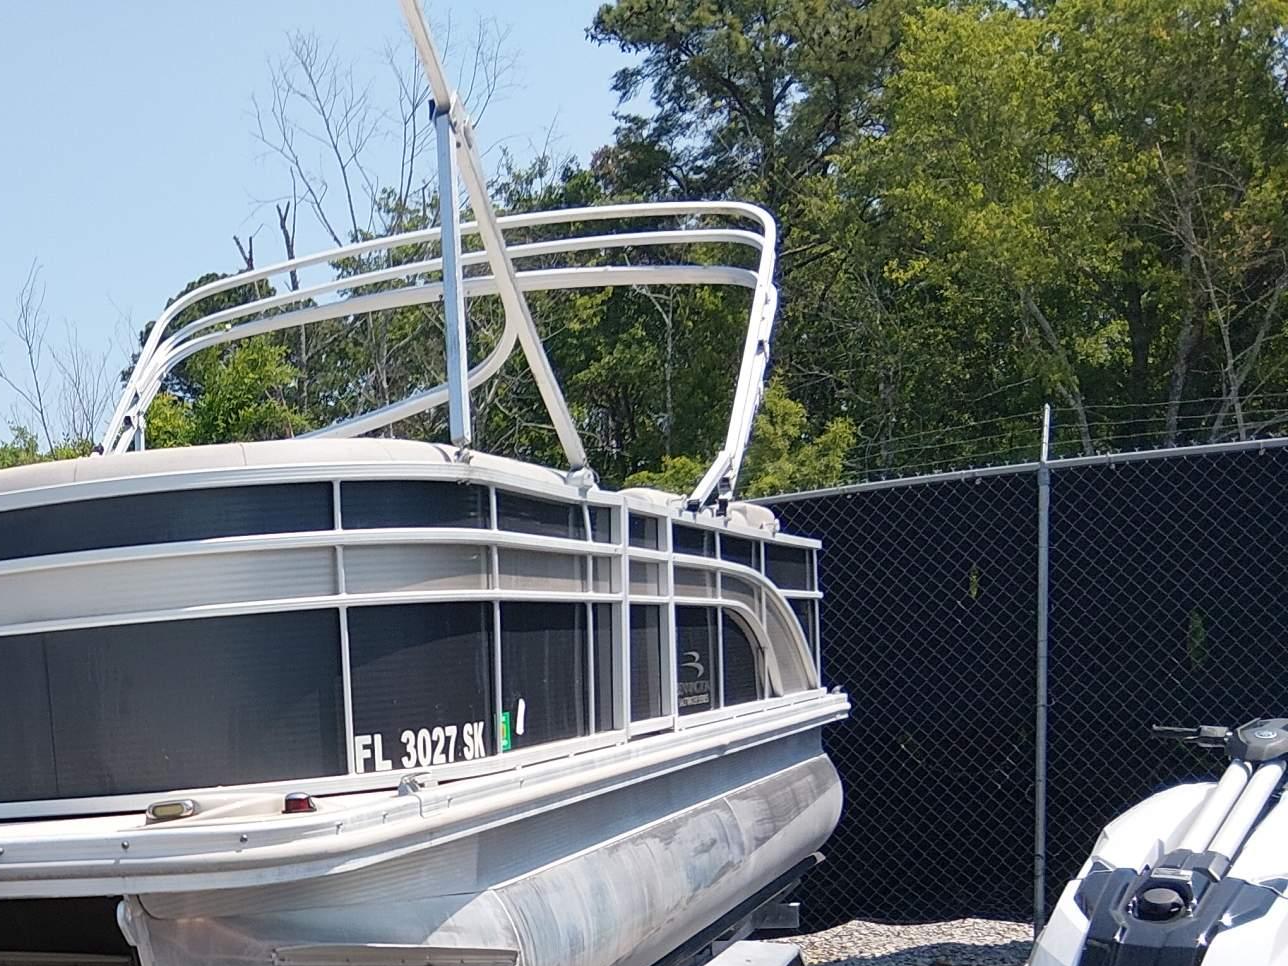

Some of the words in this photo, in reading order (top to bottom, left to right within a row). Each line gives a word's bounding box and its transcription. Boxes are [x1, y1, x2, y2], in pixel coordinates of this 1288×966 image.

[354, 733, 393, 774] FL
[400, 724, 458, 769] 3027
[462, 720, 486, 761] SK
